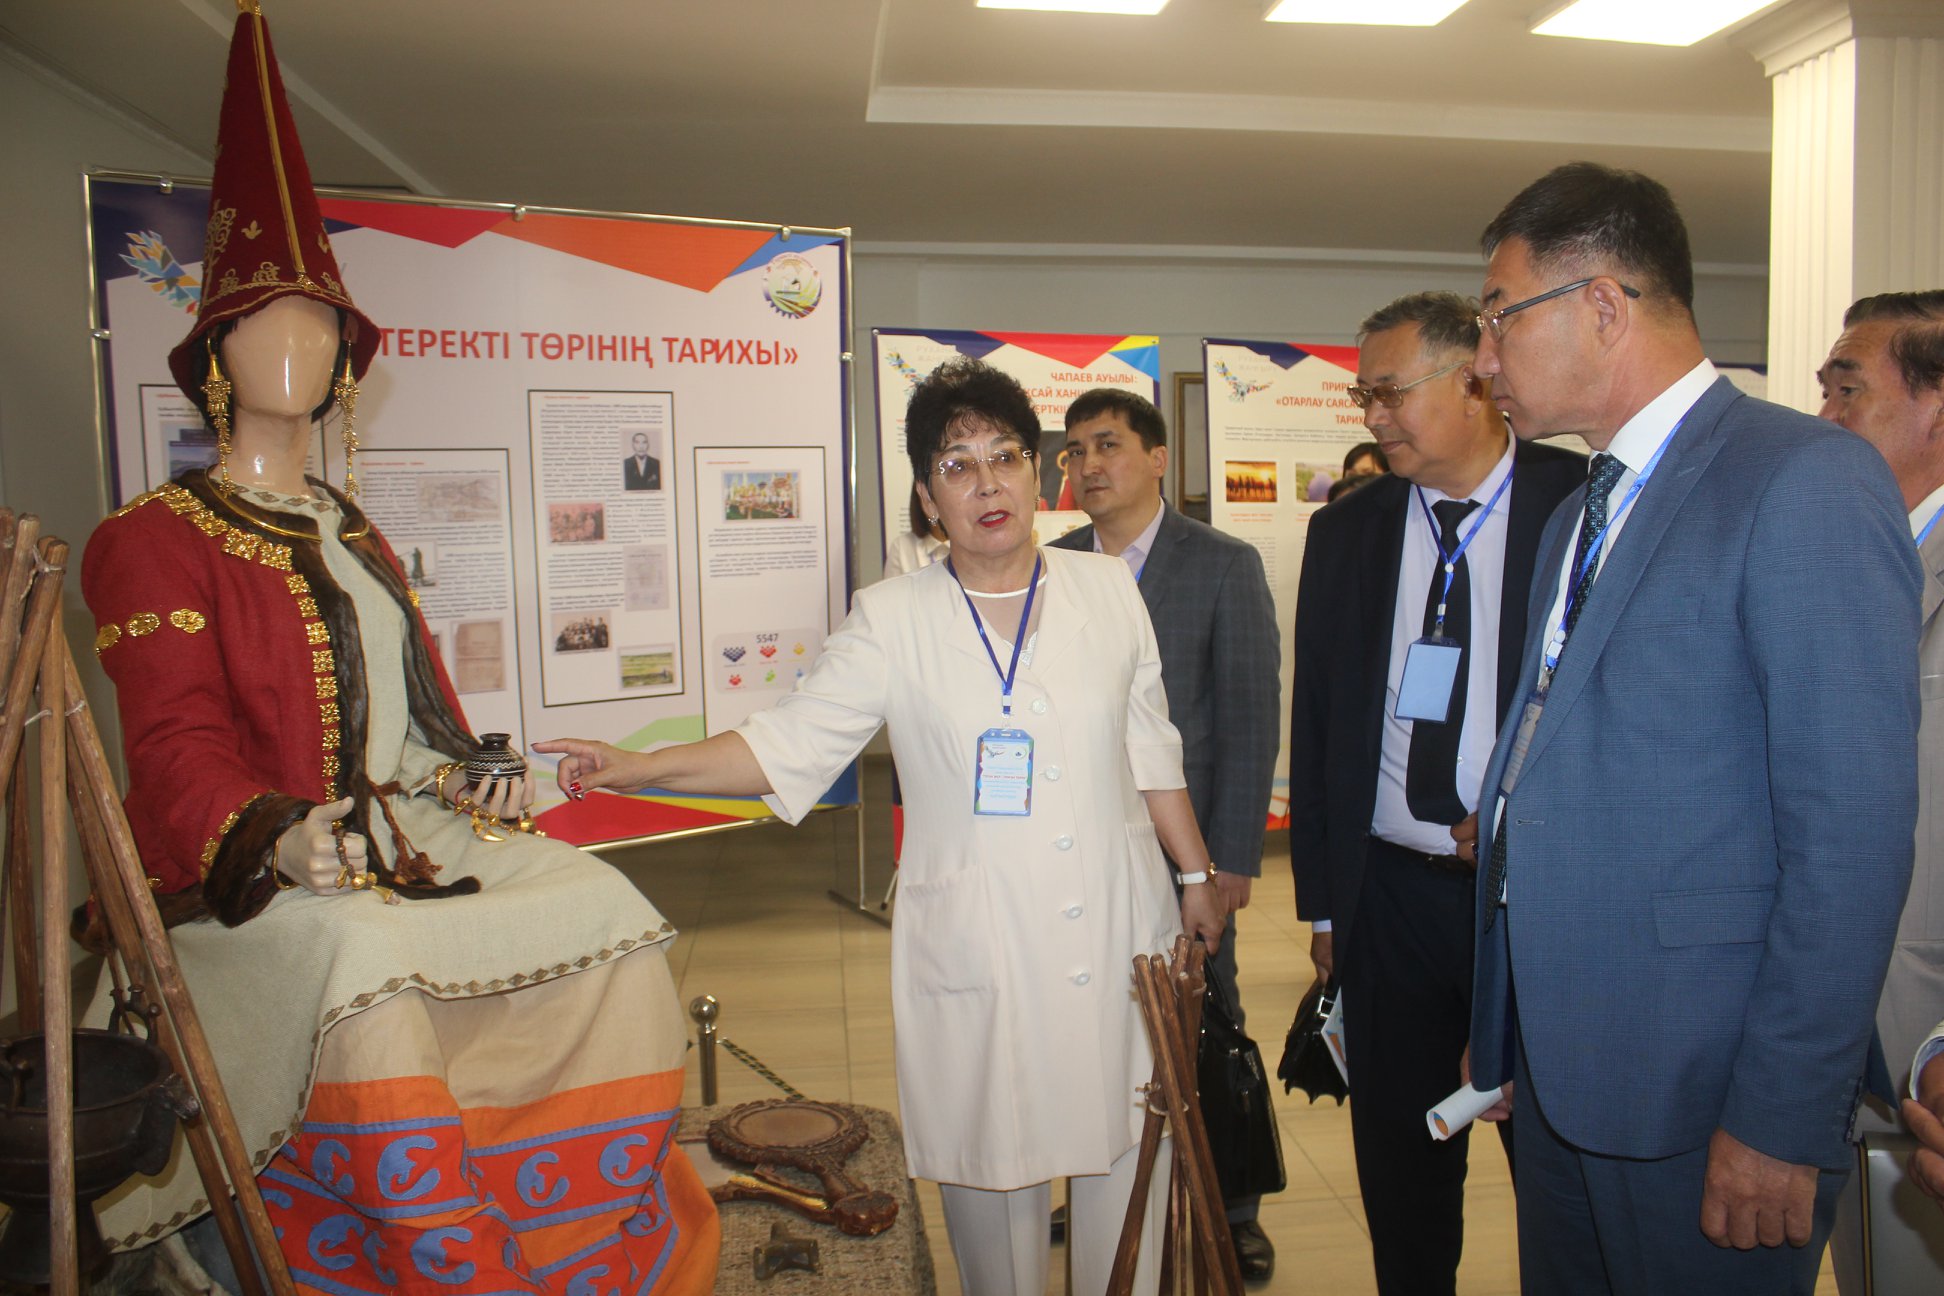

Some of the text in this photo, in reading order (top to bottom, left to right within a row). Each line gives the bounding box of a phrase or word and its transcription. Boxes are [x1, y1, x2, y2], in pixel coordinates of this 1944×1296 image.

[379, 327, 799, 368] ТЕРЕКТІ ТӨРІНІҢ ТАРИХЫ»
[1051, 372, 1138, 384] ЧАПАЕВ АУЫЛЫ:
[1336, 415, 1365, 425] ТАРИХ
